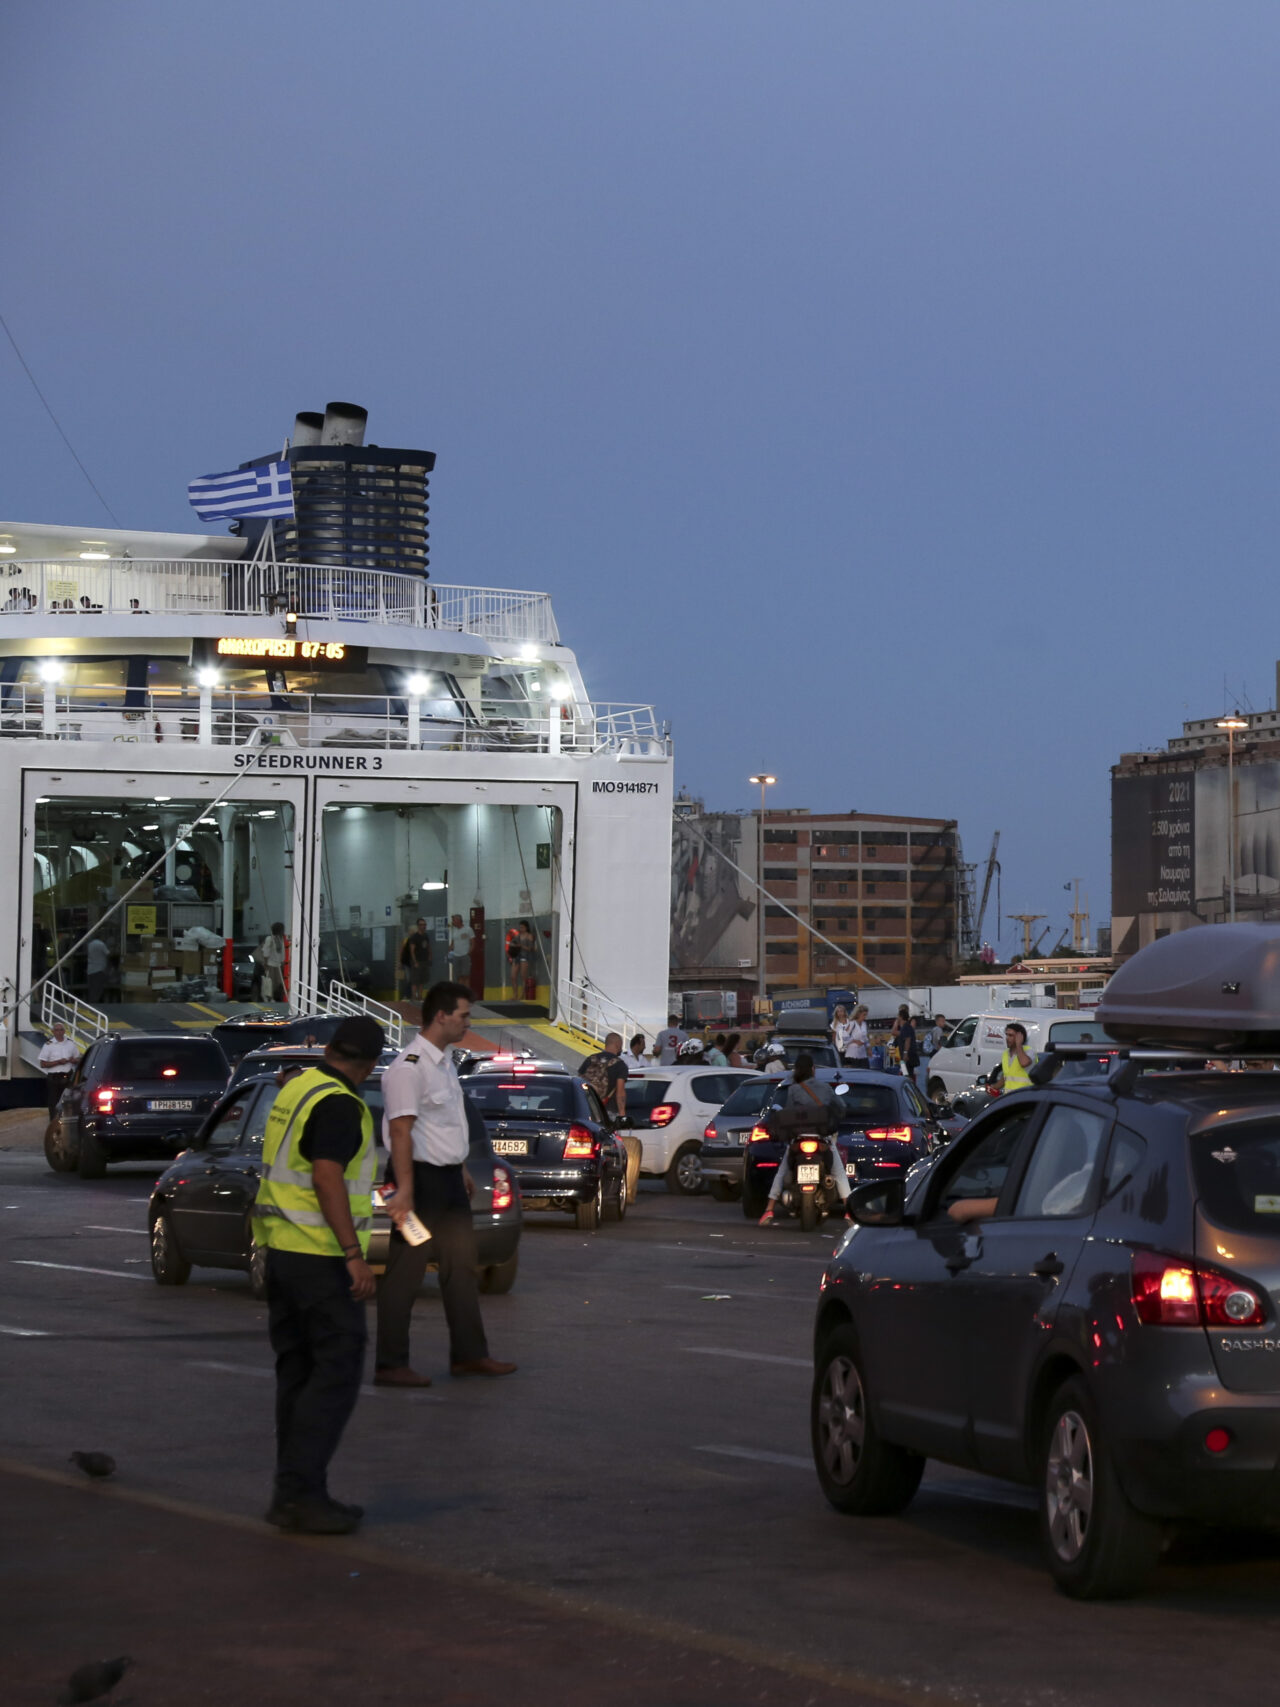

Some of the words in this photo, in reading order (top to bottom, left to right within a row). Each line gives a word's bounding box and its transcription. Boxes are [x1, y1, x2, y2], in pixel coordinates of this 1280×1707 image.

[301, 641, 344, 659] 07:05
[234, 754, 367, 769] SPEEDRUNNER
[373, 757, 382, 770] 3
[592, 782, 615, 793] IMO
[617, 782, 658, 794] 9141871
[1169, 782, 1190, 803] 2021
[1169, 819, 1190, 838] χρόνια
[1168, 842, 1182, 857] από
[1160, 864, 1190, 883] Ναυμαχία
[668, 1035, 678, 1047] 3
